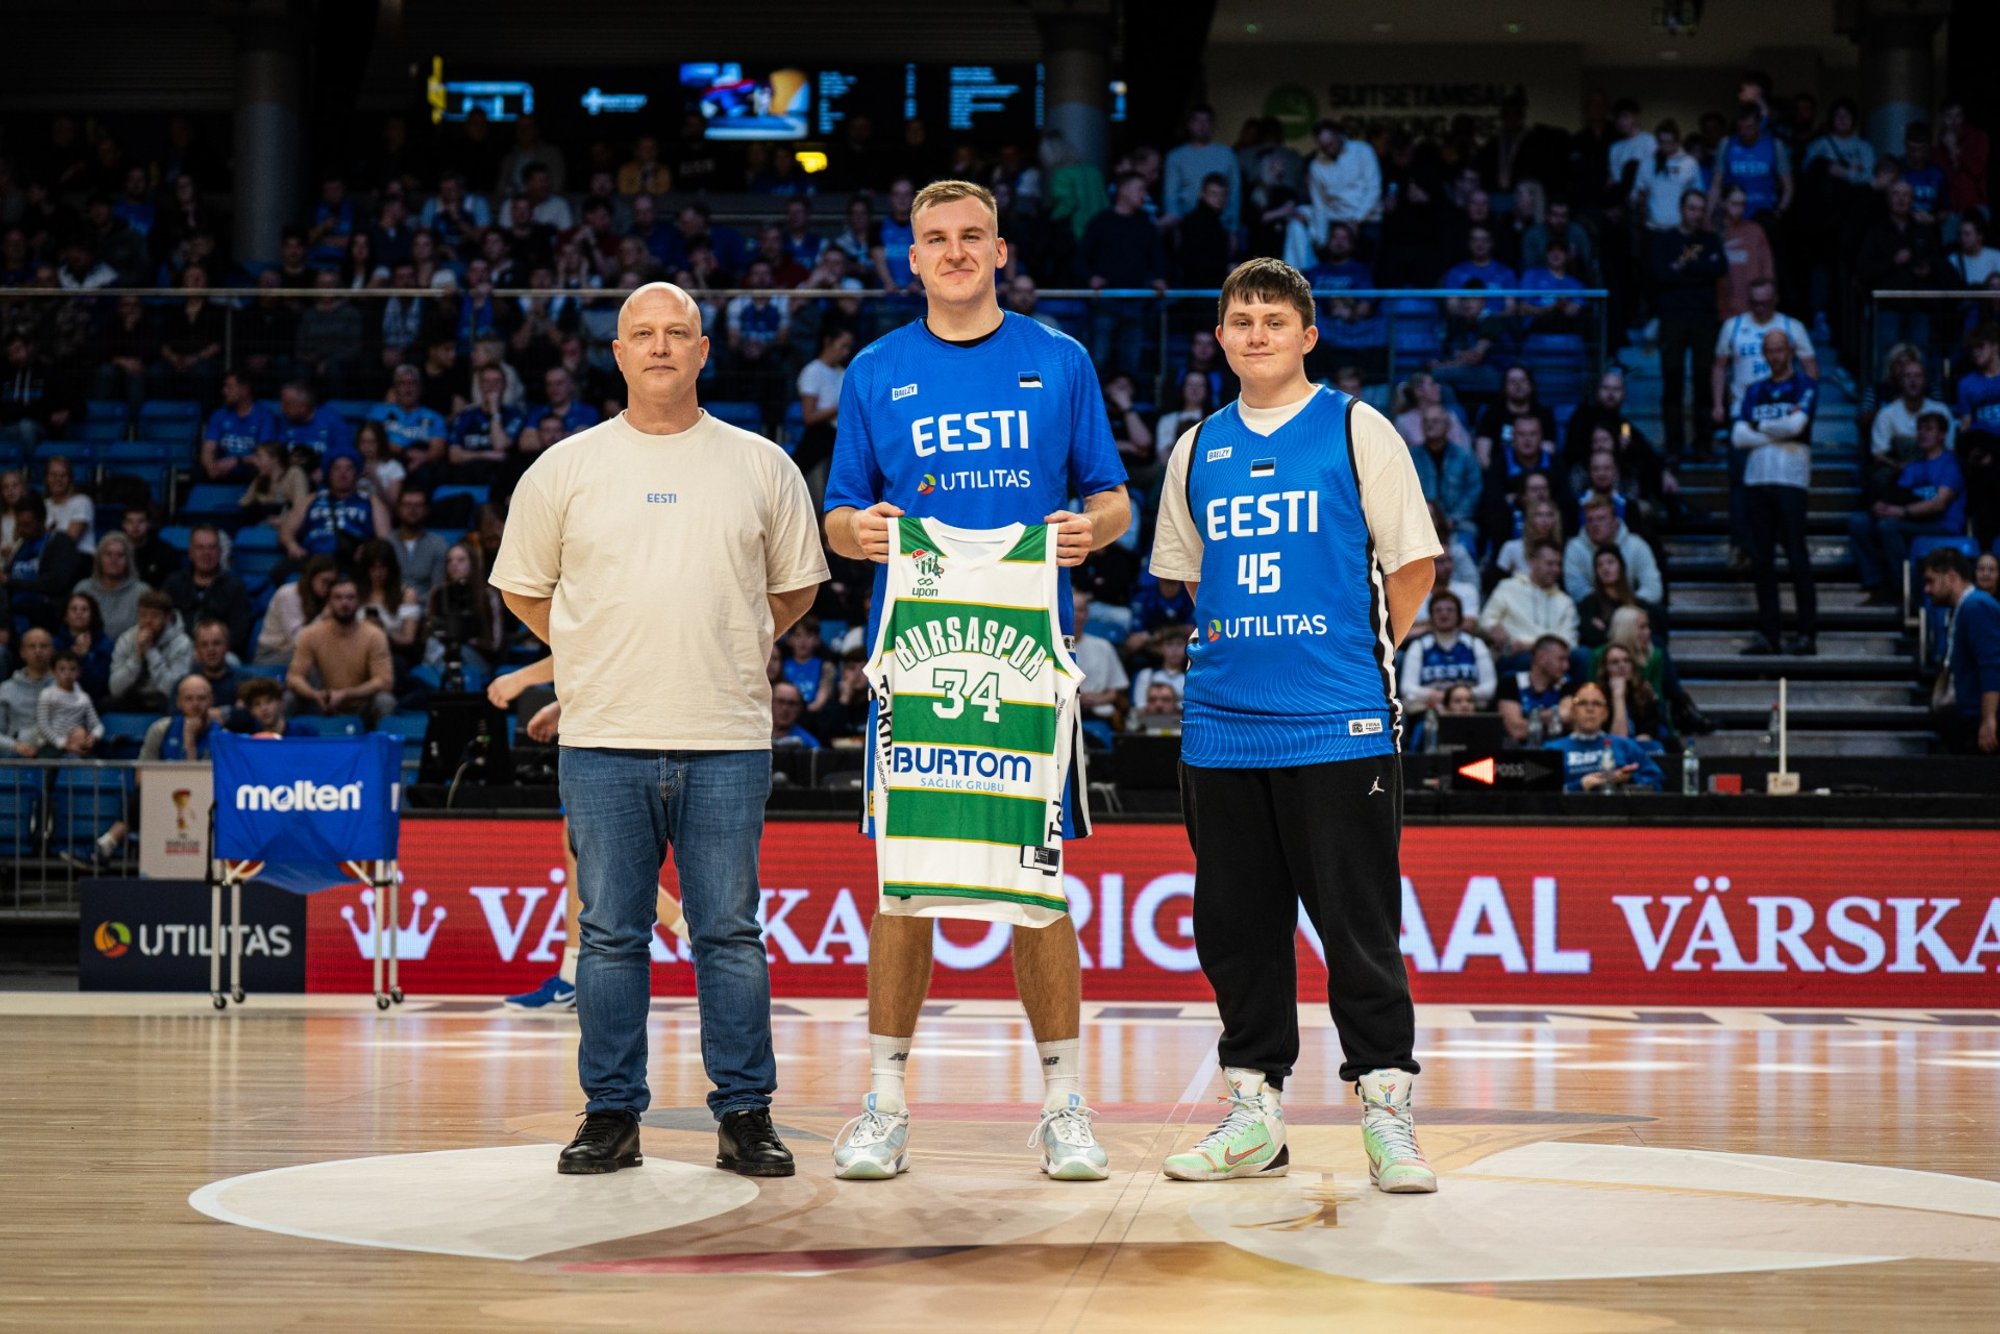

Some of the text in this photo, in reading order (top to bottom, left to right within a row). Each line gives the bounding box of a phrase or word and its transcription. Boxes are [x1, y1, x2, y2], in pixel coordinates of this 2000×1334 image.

[911, 410, 1029, 458] EESTI
[941, 469, 1031, 491] UTILITAS
[647, 493, 677, 503] EESTI
[1206, 490, 1318, 541] EESTI
[1237, 551, 1281, 595] 45
[912, 586, 939, 598] upon
[1225, 614, 1328, 639] UTILITAS
[895, 616, 1047, 681] BURSASPOR
[932, 668, 1002, 724] 34
[236, 780, 361, 812] molten
[920, 777, 1005, 793] SAĞLIK GRUBU
[468, 868, 871, 964] VÄKA
[931, 873, 1592, 972] ORIGAL
[139, 924, 292, 957] UTILITAS
